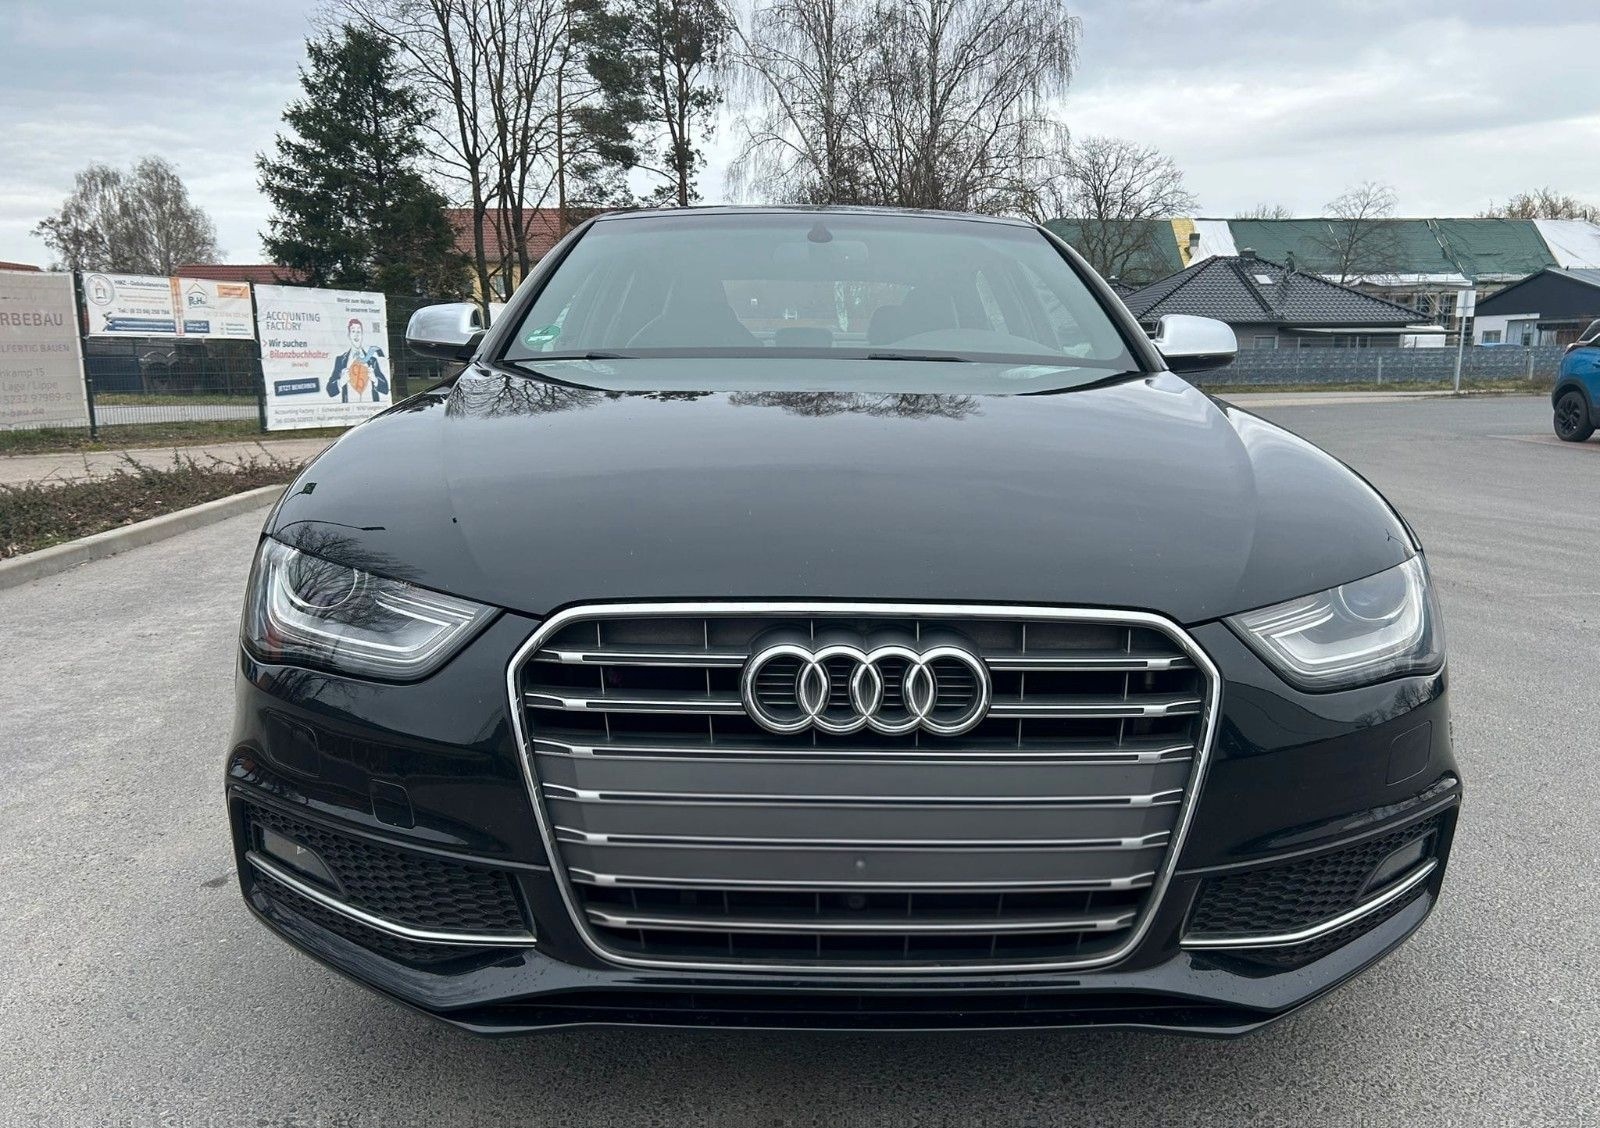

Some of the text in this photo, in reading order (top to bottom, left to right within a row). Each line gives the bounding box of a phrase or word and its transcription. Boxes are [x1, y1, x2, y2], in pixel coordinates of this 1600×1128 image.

[266, 311, 320, 322] ACCOUNTING
[266, 321, 301, 330] FACTORY
[268, 339, 307, 348] Wir suchen
[269, 349, 329, 359] Bilanzbuchhalter
